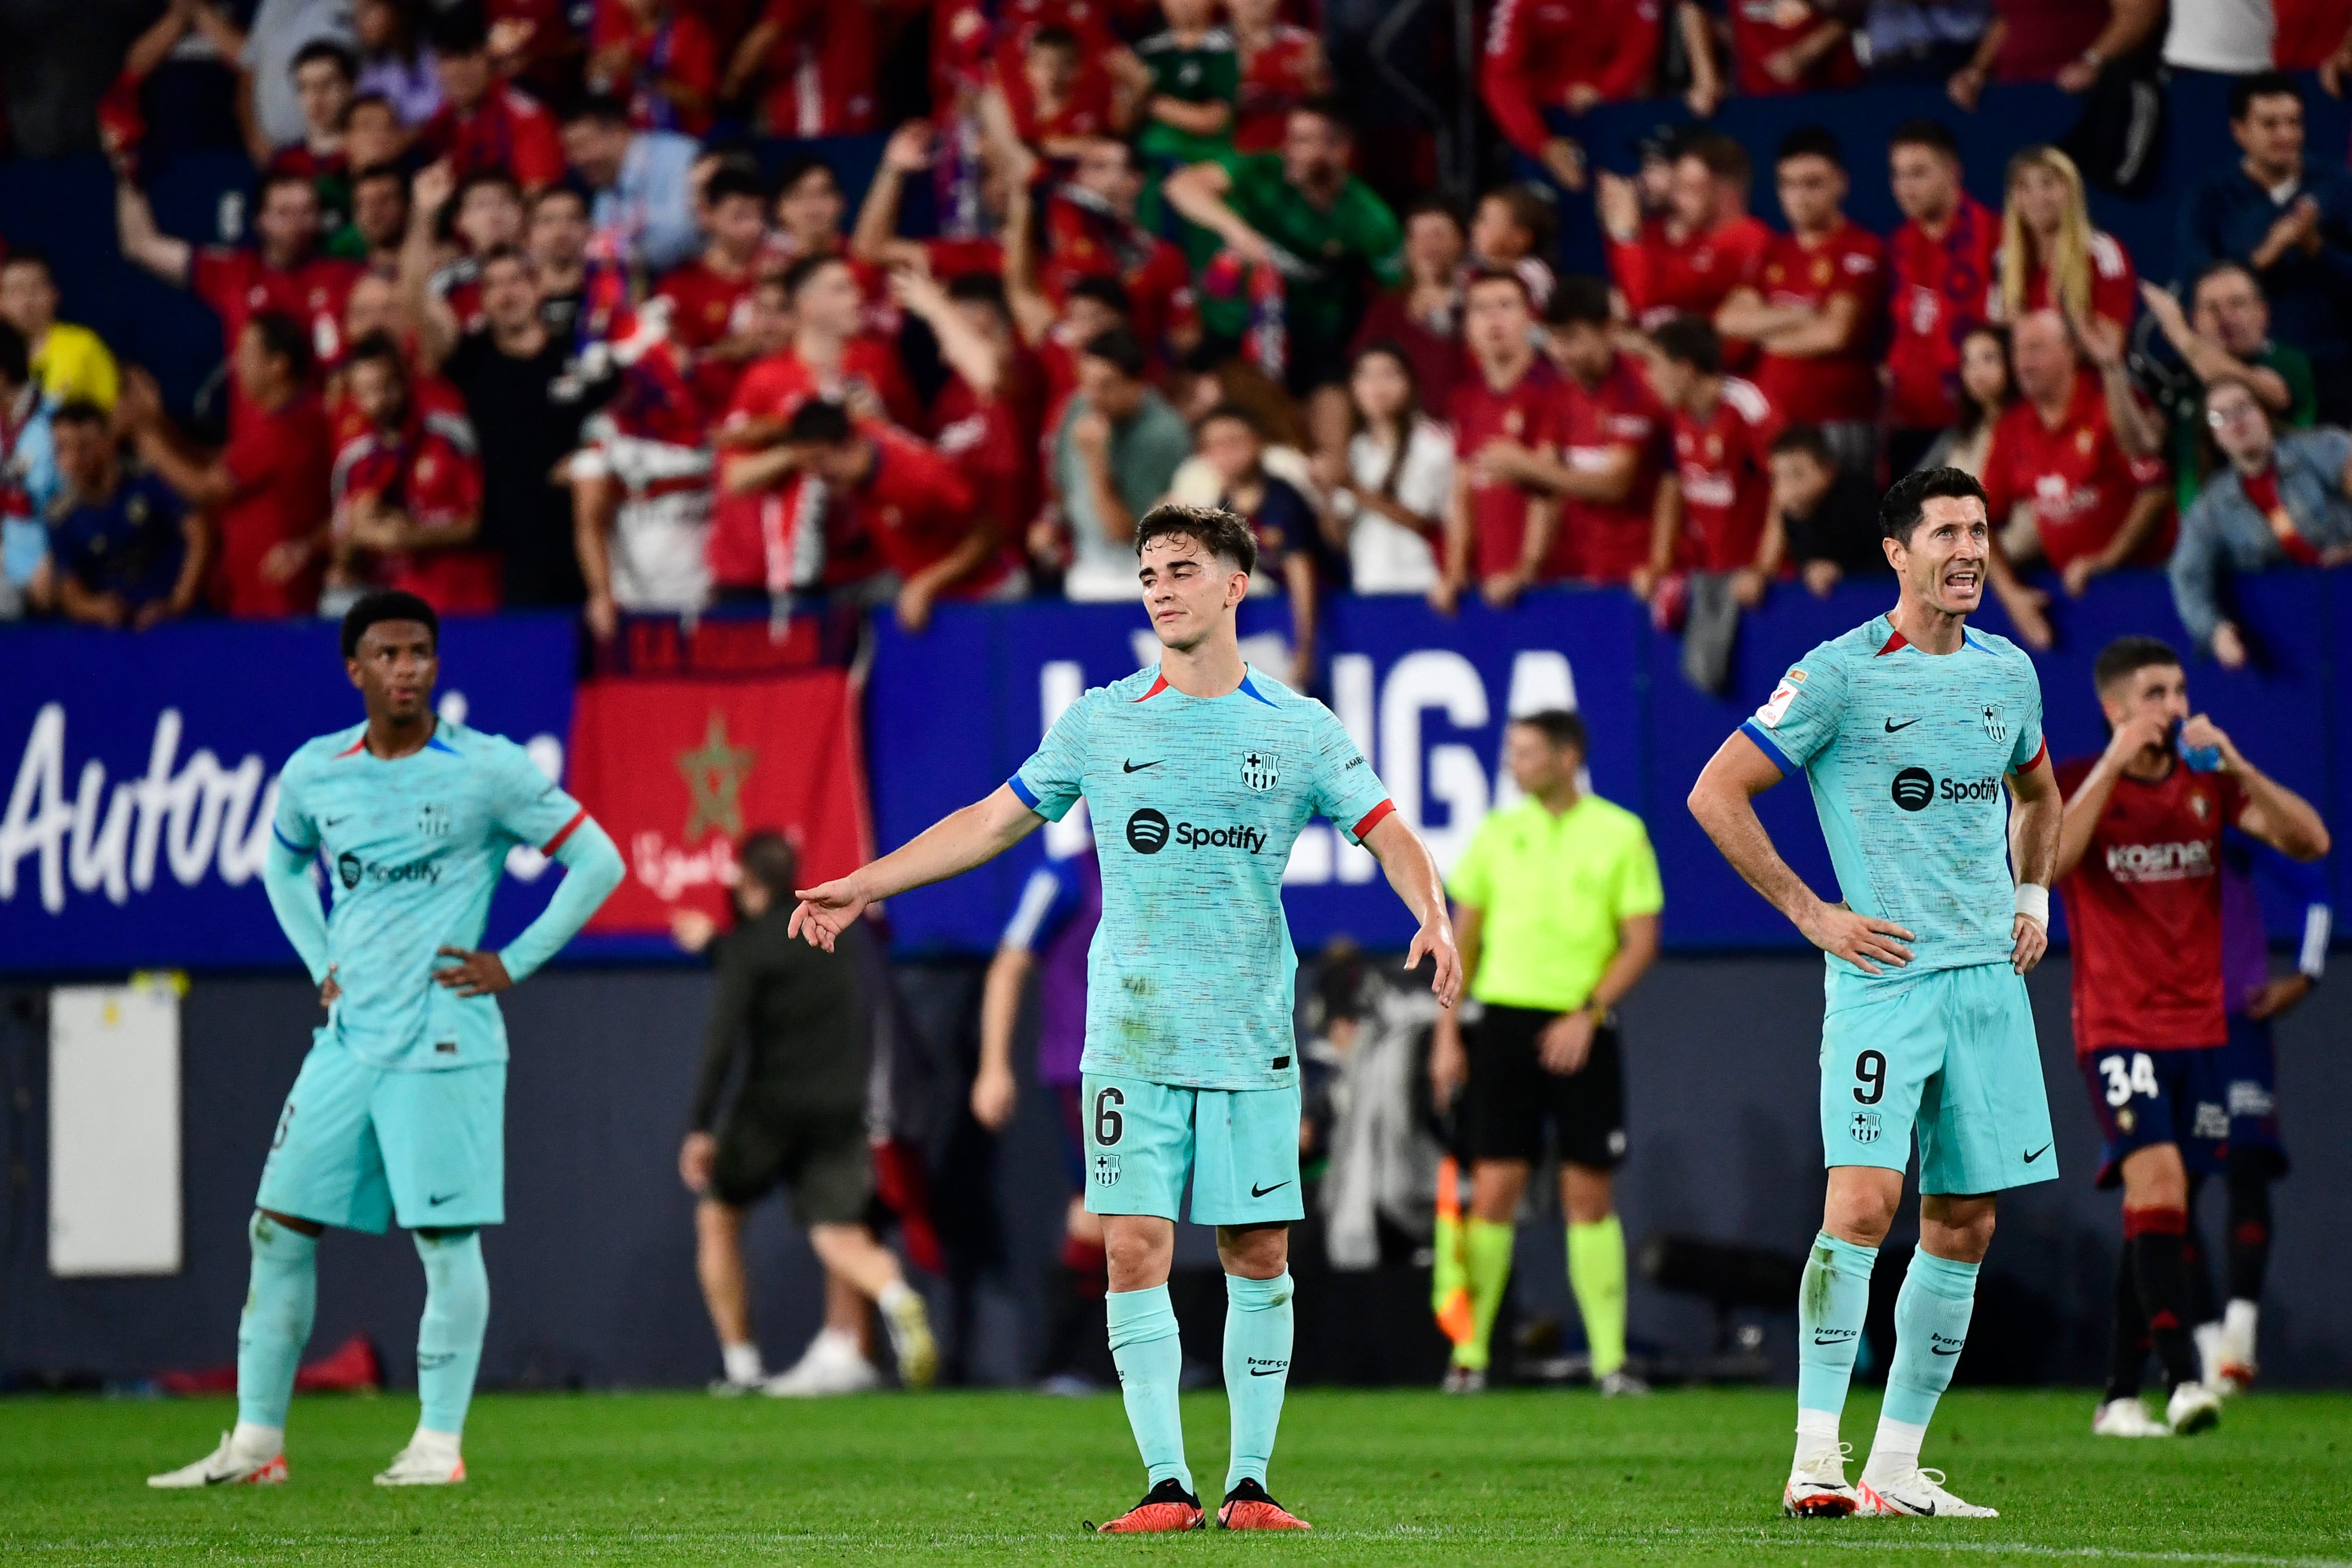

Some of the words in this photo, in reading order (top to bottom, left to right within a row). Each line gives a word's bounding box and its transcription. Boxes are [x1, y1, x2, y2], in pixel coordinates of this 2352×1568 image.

[1940, 777, 1999, 804] Spotify
[1176, 822, 1267, 855] Spotify
[1853, 1048, 1887, 1105] 9
[2099, 1051, 2159, 1108] 34
[1094, 1086, 1126, 1147] 6
[1815, 1327, 1857, 1337] barça
[1247, 1356, 1288, 1367] barça
